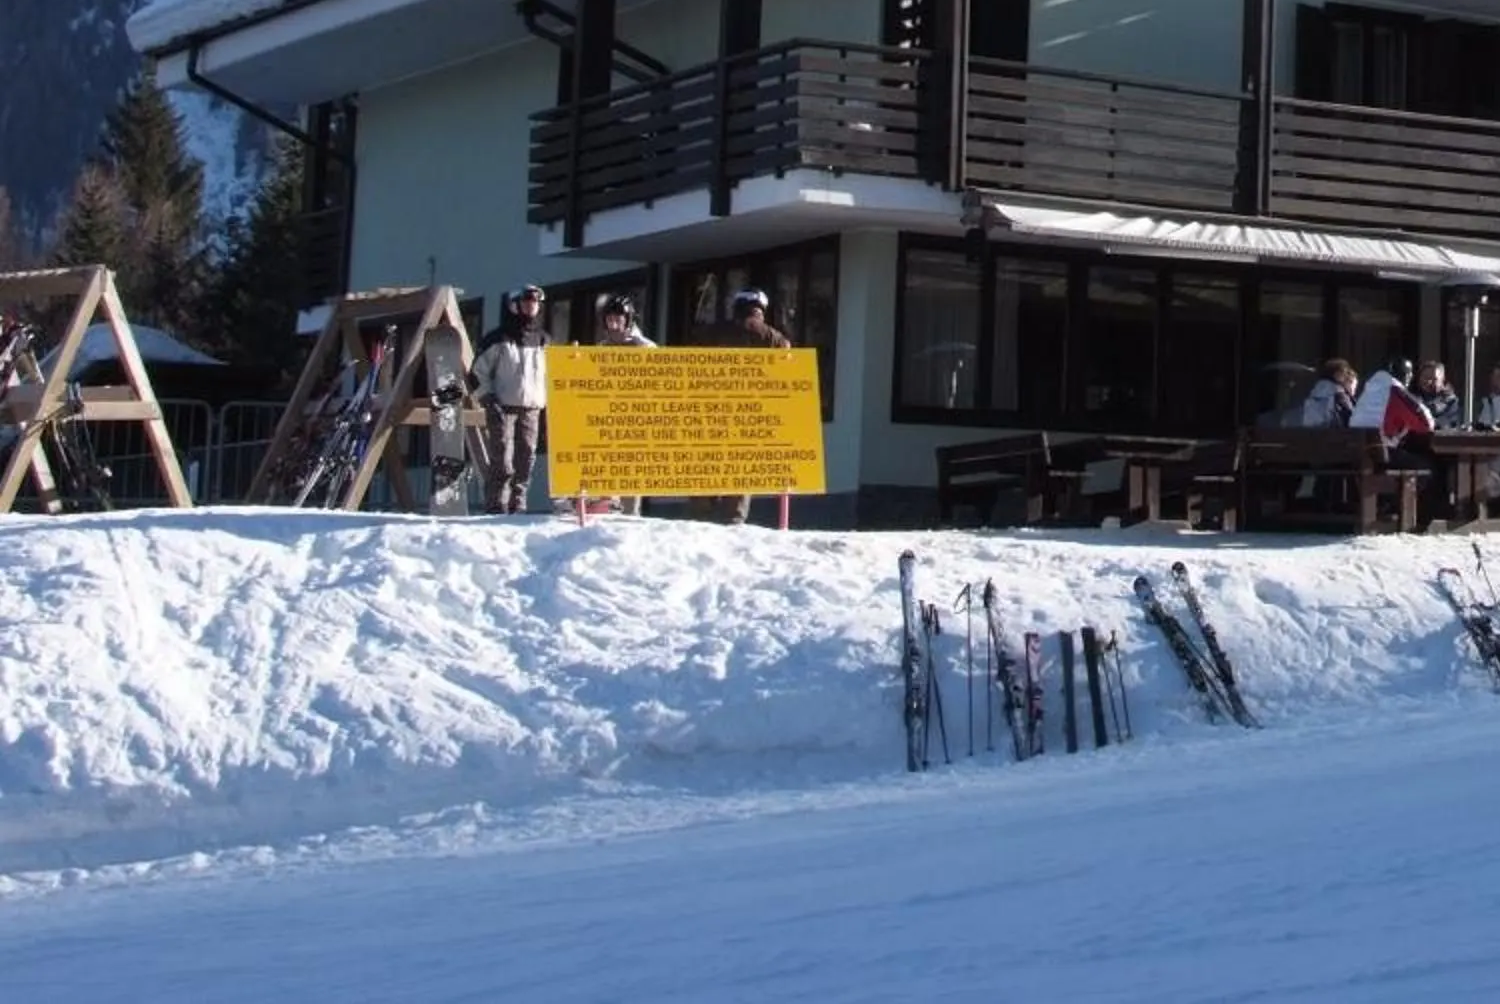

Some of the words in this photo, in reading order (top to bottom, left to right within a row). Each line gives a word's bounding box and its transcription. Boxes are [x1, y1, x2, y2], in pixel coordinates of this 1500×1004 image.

[589, 352, 642, 364] VIETATO
[646, 353, 740, 364] ABBANDONARE
[743, 353, 765, 365] SCI
[767, 354, 775, 365] E
[599, 366, 684, 377] SNOWBOARD
[687, 366, 726, 378] SULLA
[553, 379, 567, 390] SI
[569, 379, 615, 390] PREGA
[617, 379, 660, 390] USARE
[662, 379, 685, 391] GLI
[687, 379, 745, 391] APPOSITI
[747, 379, 789, 391] PORTA
[609, 402, 629, 413] DO
[631, 402, 658, 413] NOT
[661, 402, 701, 413] LEAVE
[704, 402, 733, 413] SKIS
[736, 402, 763, 413] AND
[586, 415, 680, 427] SNOWBOARDS
[684, 415, 703, 426] ON
[706, 415, 731, 426] THE
[599, 428, 648, 441] PLEASE
[651, 428, 676, 440] USE
[680, 428, 705, 440] THE
[707, 428, 729, 440] SKI
[556, 451, 573, 463] ES
[576, 451, 597, 463] IST
[599, 451, 669, 463] VERBOTEN
[673, 451, 693, 462] SKI
[697, 451, 724, 462] UND
[727, 450, 816, 461] SNOWBOARDS
[581, 465, 606, 476] AUF
[609, 465, 630, 476] DIE
[634, 465, 671, 476] PISTE
[674, 464, 721, 475] LIEGEN
[723, 464, 740, 475] ZU
[579, 478, 616, 490] BITTE
[619, 478, 641, 489] DIE
[644, 477, 729, 488] SKIGESTELLE
